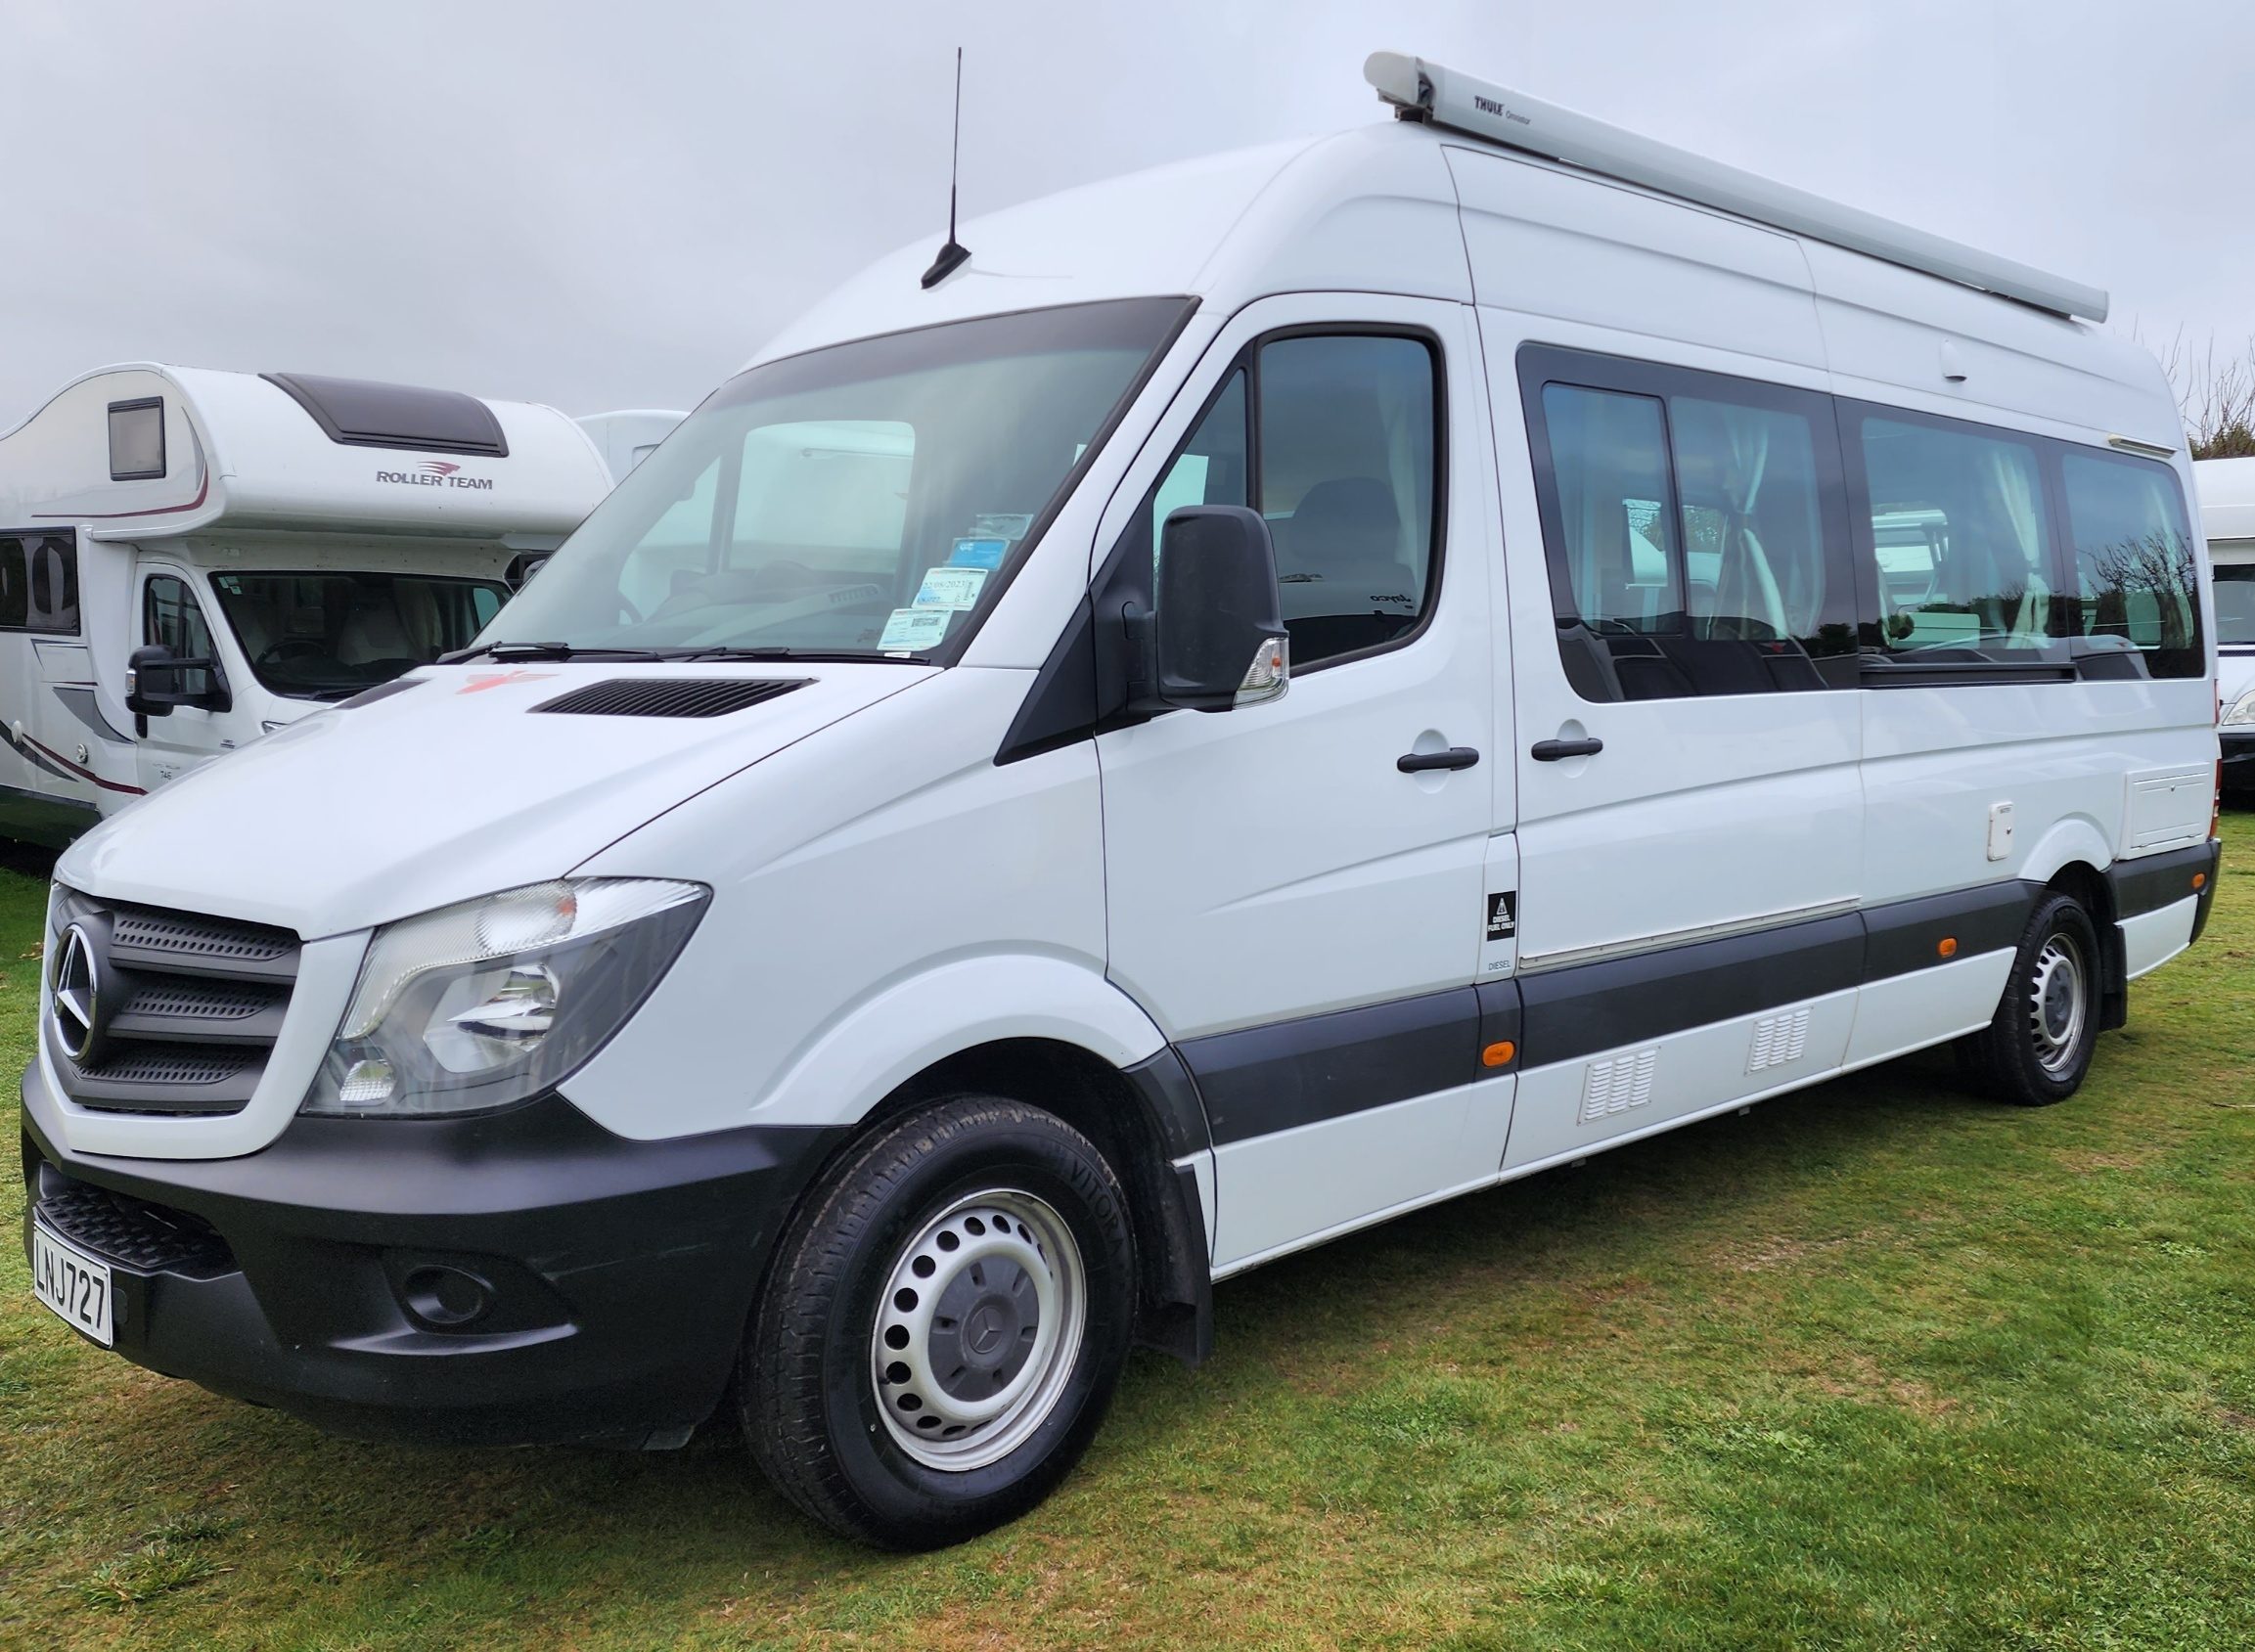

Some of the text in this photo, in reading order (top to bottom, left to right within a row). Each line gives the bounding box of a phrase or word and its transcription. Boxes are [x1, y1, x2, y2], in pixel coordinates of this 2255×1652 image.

[1474, 95, 1505, 116] THULE
[376, 470, 493, 490] ROLLER TEAM
[1489, 960, 1511, 970] DIESEL
[35, 1237, 106, 1330] LNJ727
